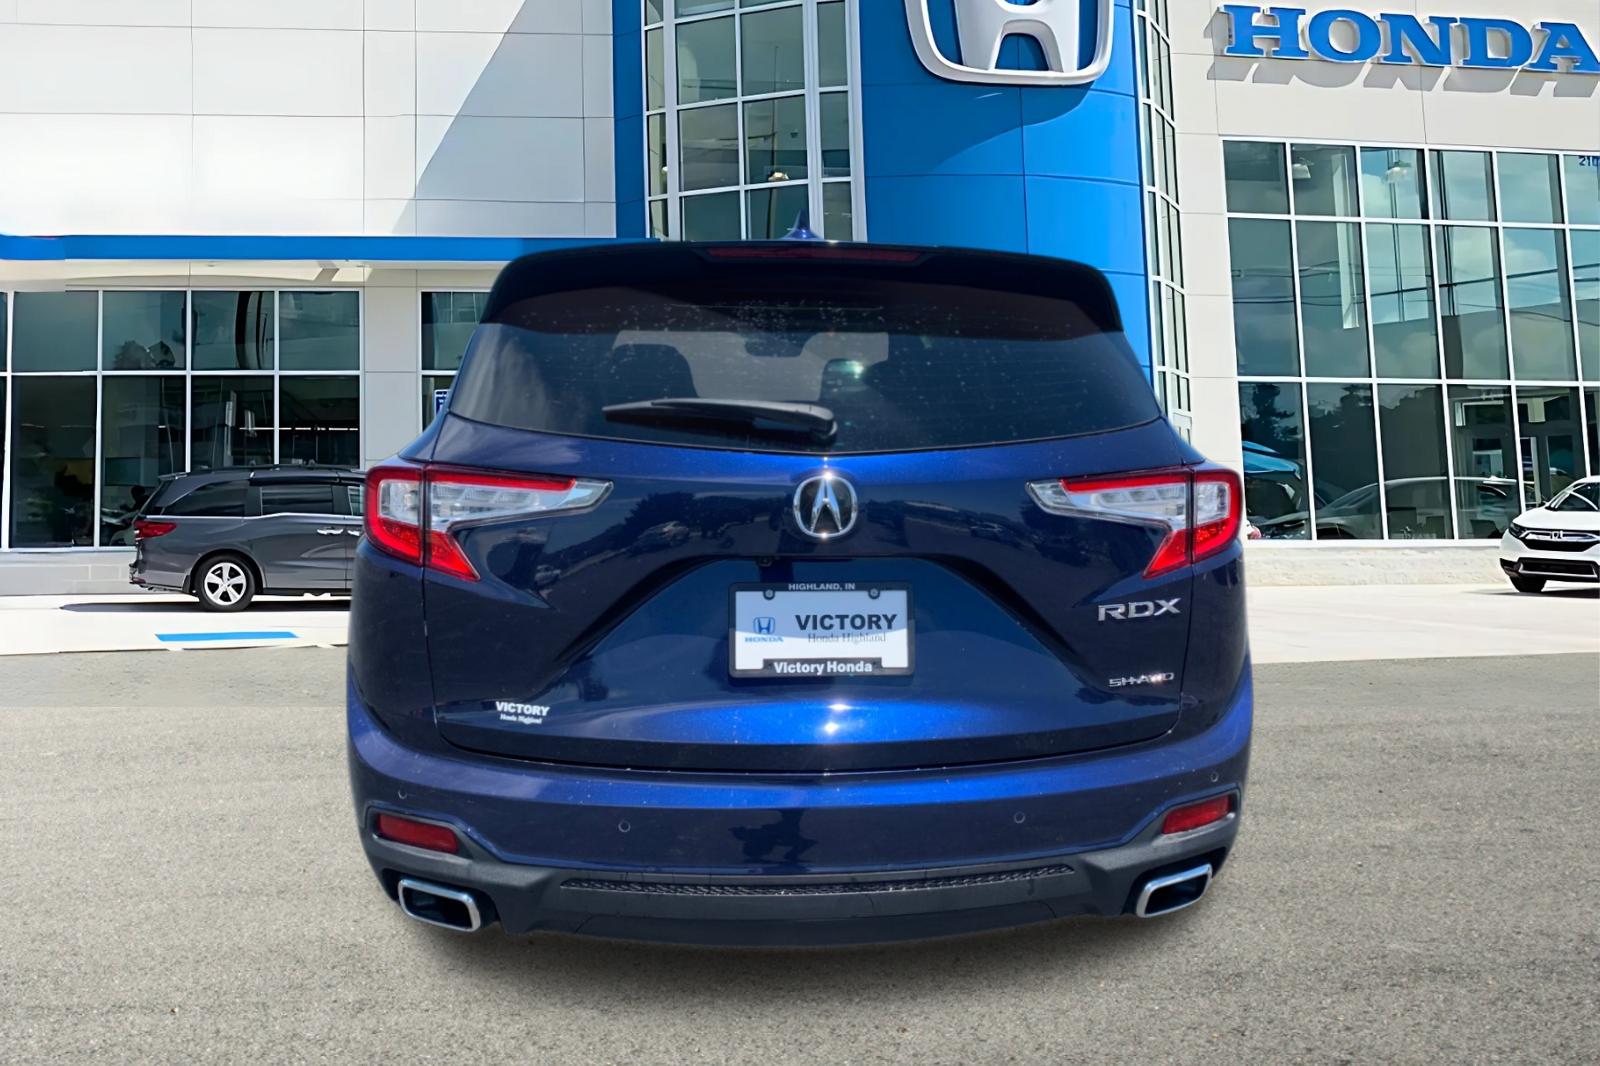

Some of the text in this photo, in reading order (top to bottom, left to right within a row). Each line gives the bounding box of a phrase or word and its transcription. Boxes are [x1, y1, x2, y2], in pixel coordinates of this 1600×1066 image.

[1222, 4, 1600, 73] HONDA
[788, 583, 843, 591] HIGHLAND,
[1098, 598, 1181, 621] RDX
[795, 614, 897, 630] VICTORY
[808, 632, 886, 645] Honda Highland
[774, 661, 872, 675] Victory Honda
[496, 701, 550, 717] VICTORY
